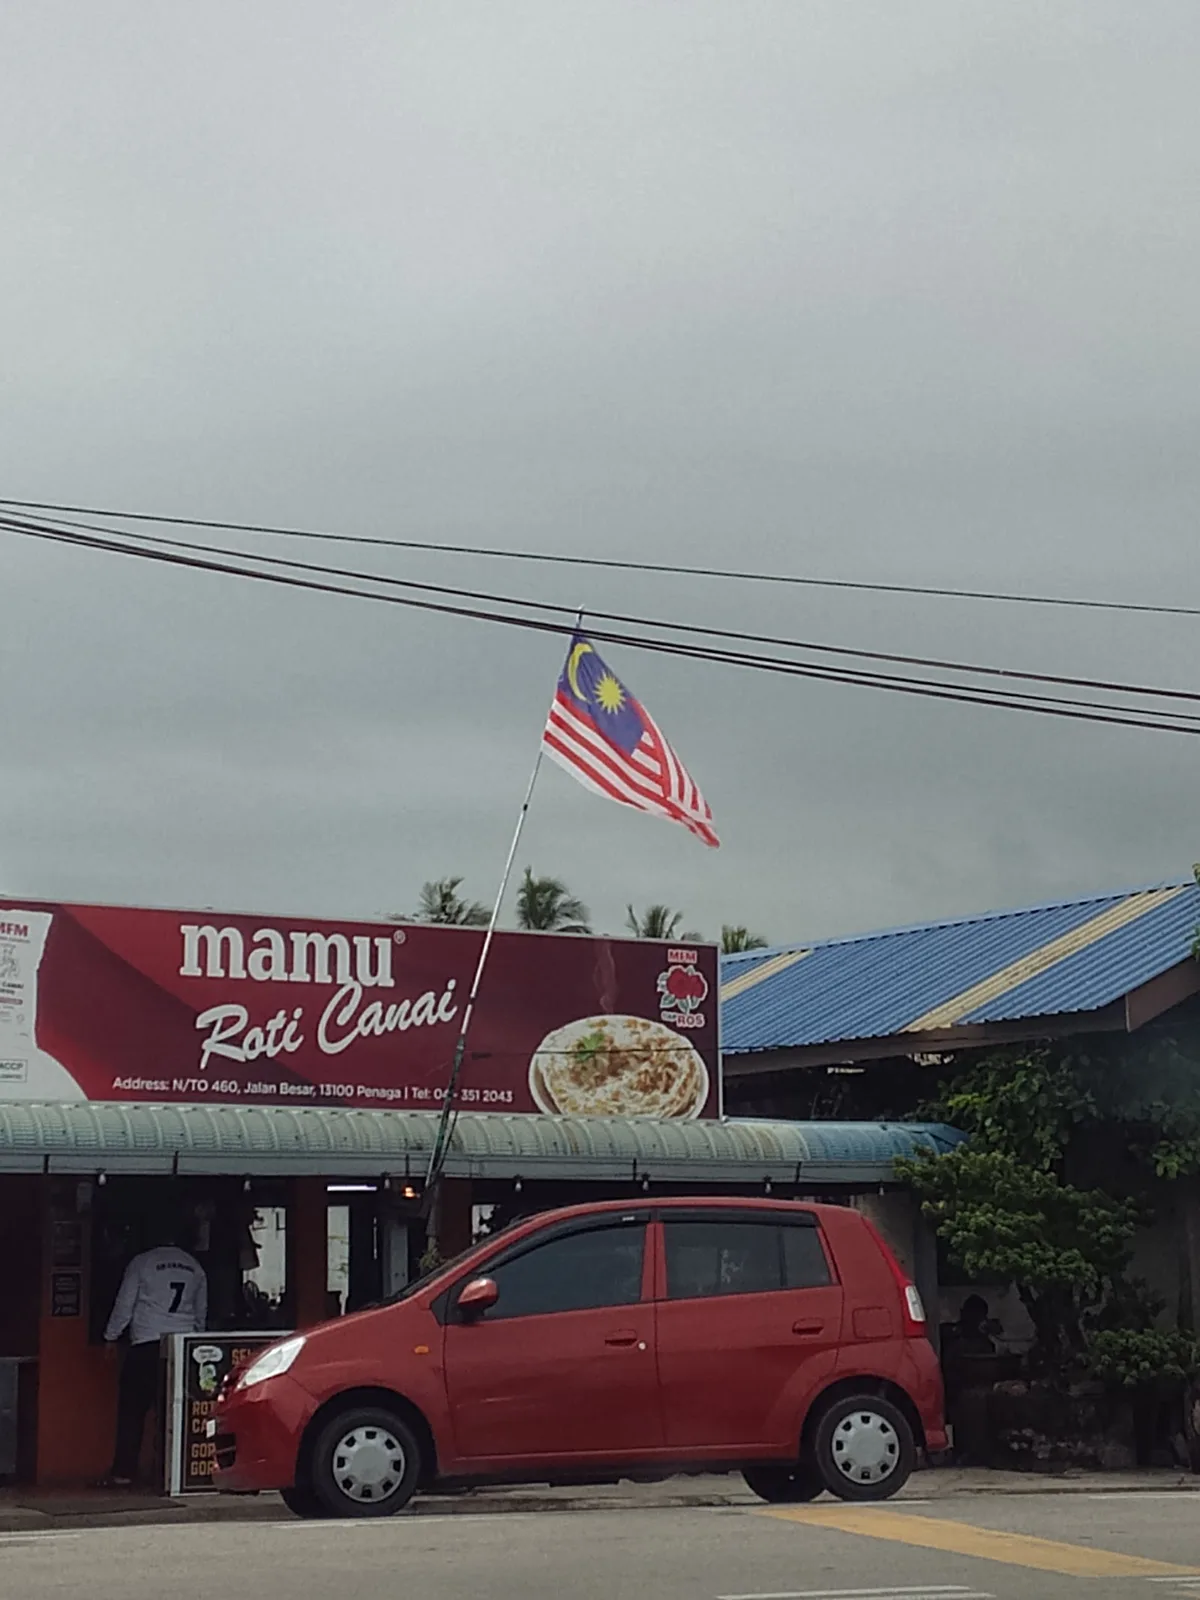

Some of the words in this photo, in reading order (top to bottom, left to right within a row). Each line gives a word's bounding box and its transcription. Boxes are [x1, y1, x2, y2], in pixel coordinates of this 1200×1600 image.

[179, 924, 395, 988] mamu
[195, 1003, 304, 1070] Roti
[317, 978, 458, 1055] Canai
[677, 1014, 705, 1027] ROS
[112, 1076, 170, 1091] Address:
[172, 1078, 209, 1092] N/TO
[211, 1079, 241, 1095] 460,
[243, 1081, 277, 1095] Jalan
[279, 1082, 317, 1097] Besar,
[320, 1084, 355, 1098] 13100
[357, 1085, 402, 1100] Penaga
[411, 1087, 432, 1100] Tel:
[461, 1089, 480, 1101] 351
[482, 1090, 513, 1103] 2043
[168, 1281, 186, 1313] 7
